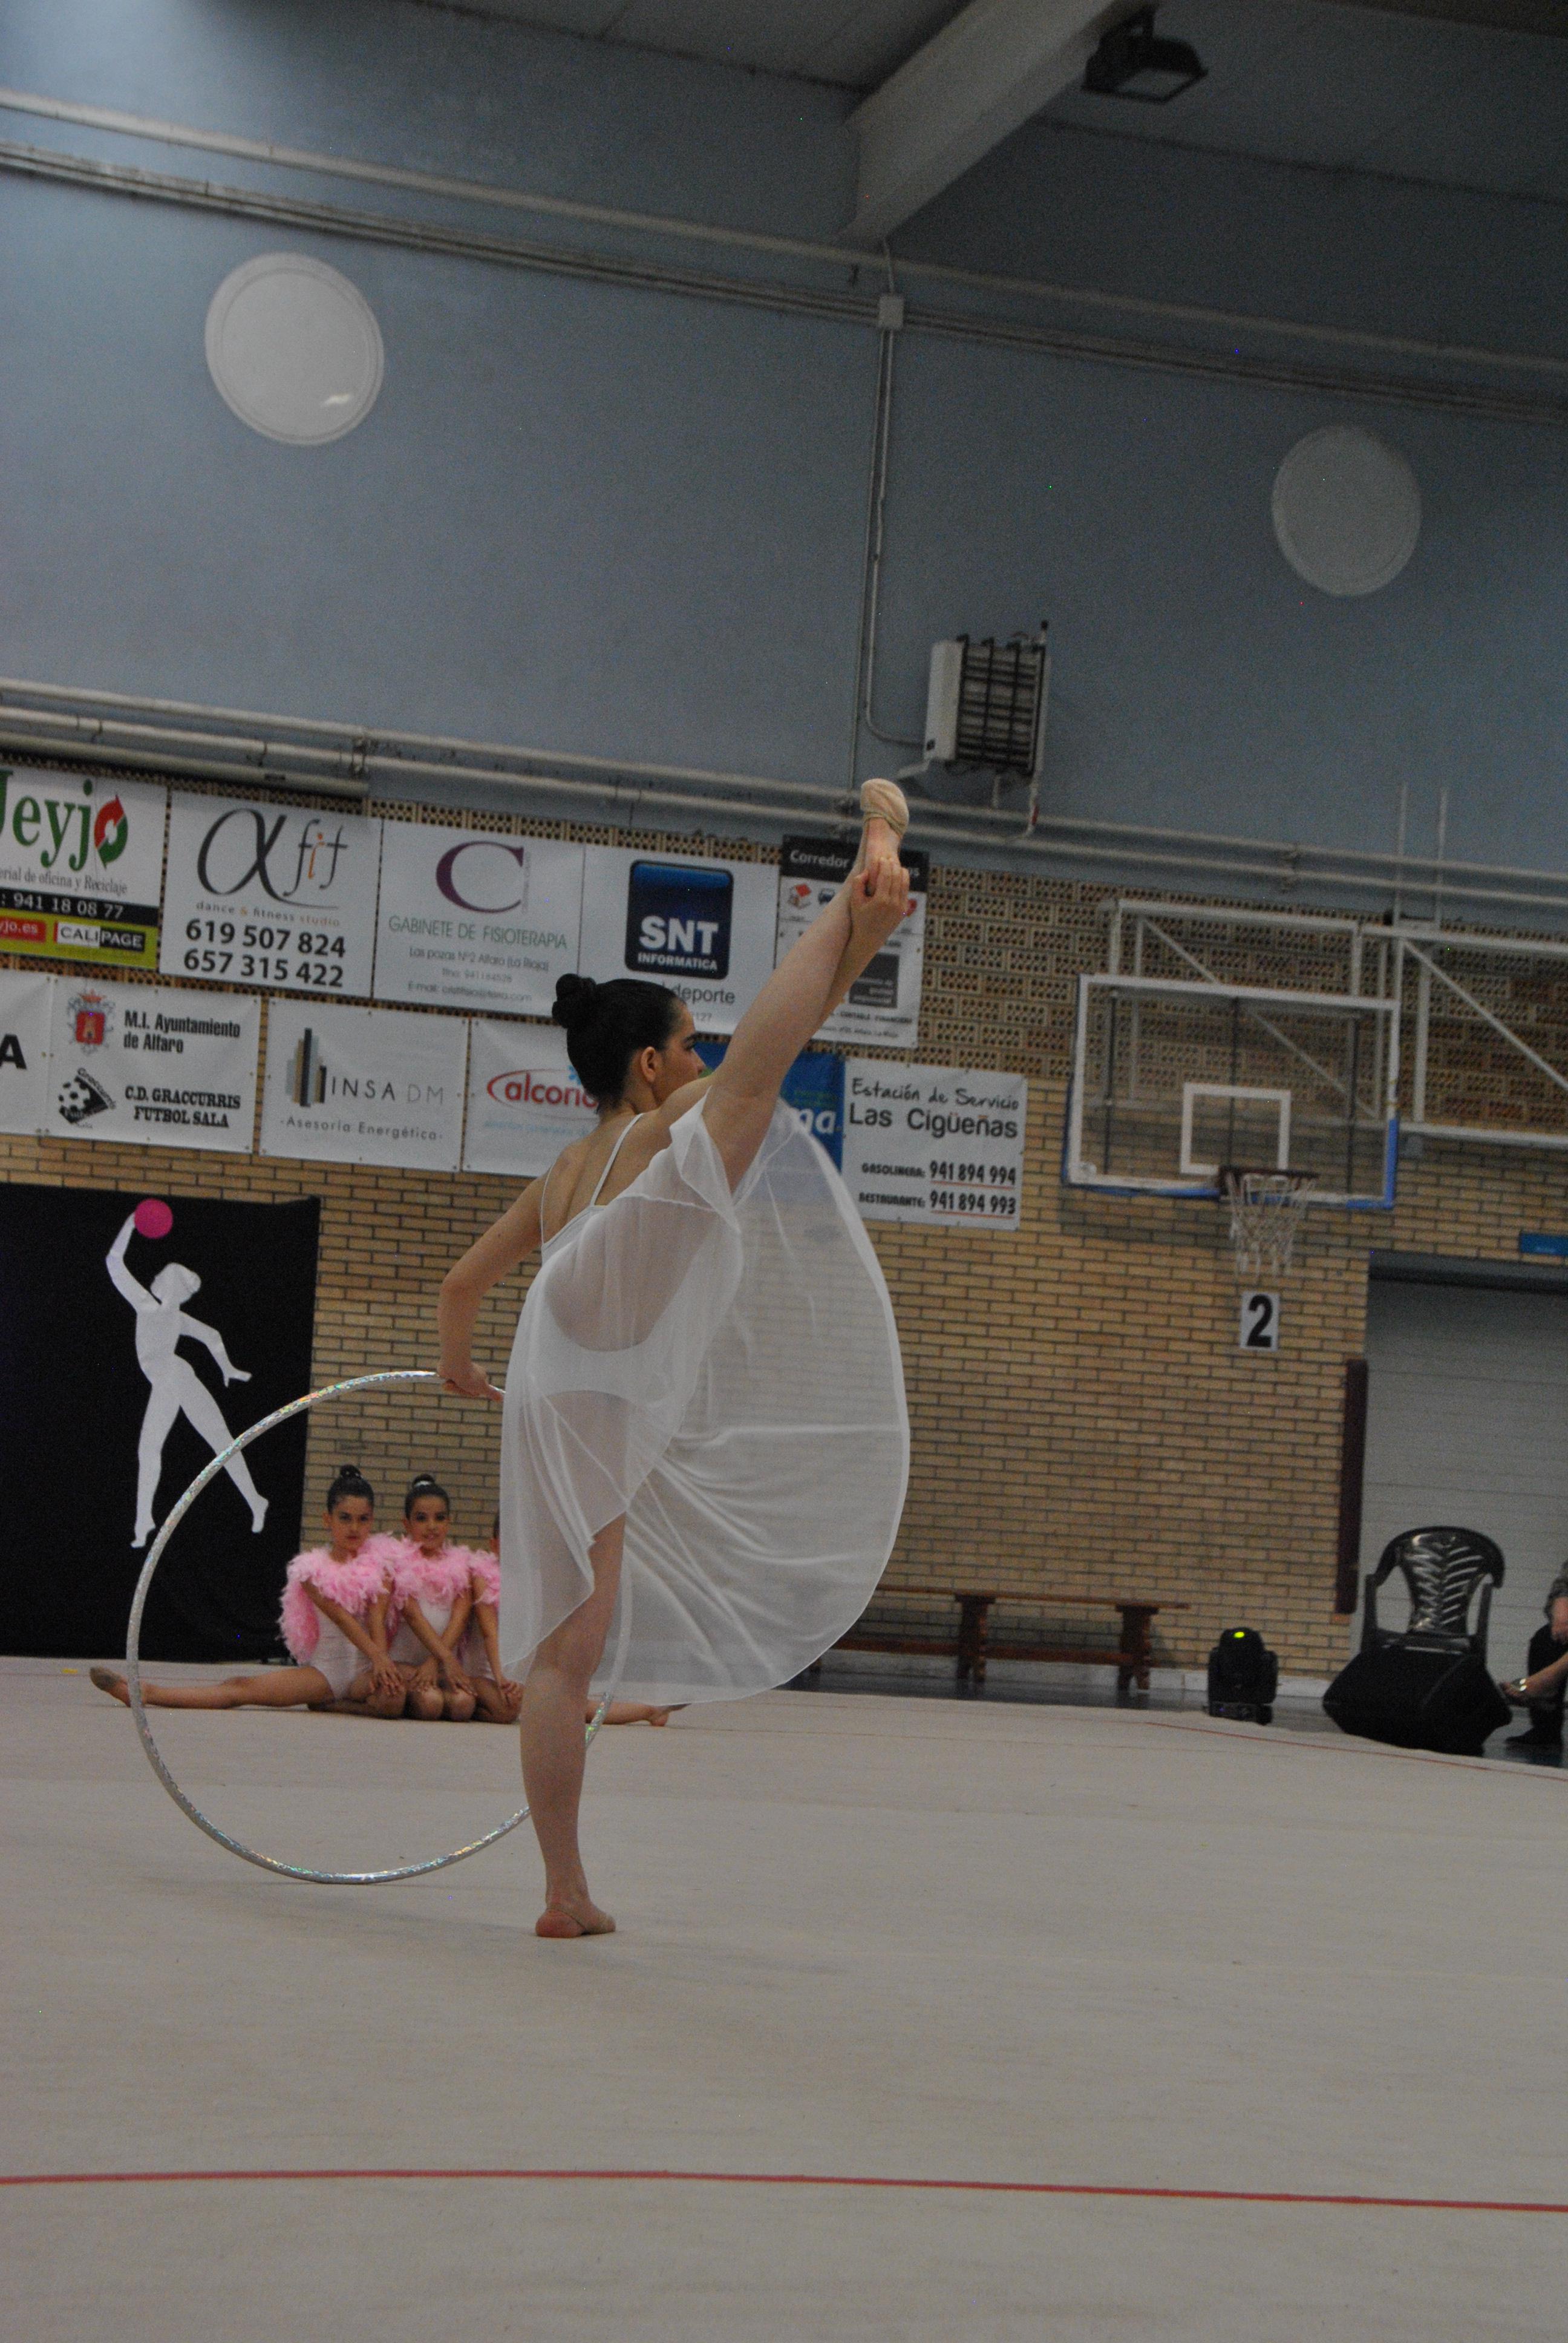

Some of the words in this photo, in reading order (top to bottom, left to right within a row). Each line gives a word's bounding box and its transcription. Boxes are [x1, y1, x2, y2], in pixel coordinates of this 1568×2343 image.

[790, 849, 849, 868] Corredor
[25, 870, 36, 883] de
[39, 871, 72, 888] oficina
[74, 878, 81, 891] y
[85, 875, 128, 896] Reciclaje
[13, 892, 43, 911] 941
[53, 897, 71, 914] 18
[77, 900, 97, 917] 08
[104, 903, 124, 919] 77
[196, 900, 235, 914] dance
[253, 908, 295, 922] fitness
[299, 915, 339, 928] studio
[186, 917, 235, 944] 619
[243, 924, 291, 951] 507
[298, 931, 346, 958] 824
[388, 915, 454, 938] GABINETE
[458, 922, 475, 940] DE
[483, 925, 567, 949] FISIOTERAPIA
[639, 915, 719, 955] SNT
[184, 948, 233, 974] 657
[241, 954, 289, 981] 315
[296, 961, 344, 988] 422
[638, 952, 717, 971] INFORMATICA
[125, 1010, 149, 1029] M.I.
[155, 1013, 241, 1038] Ayuntamiento
[124, 1031, 139, 1049] de
[143, 1033, 184, 1054] Alfaro
[125, 1086, 149, 1101] C.D.
[152, 1088, 241, 1110] GRACCURRIS
[332, 1076, 396, 1101] INSA
[407, 1084, 444, 1106] DM
[852, 1077, 920, 1101] Estación
[929, 1087, 949, 1104] de
[955, 1087, 1019, 1111] Servicio
[134, 1106, 191, 1124] FUTBOL
[193, 1112, 229, 1128] SALA
[849, 1103, 892, 1127] Las
[907, 1107, 1018, 1139] Cigüeñas
[861, 1162, 926, 1178] GASOLINERA:
[930, 1160, 955, 1180] 941
[958, 1163, 985, 1183] 894
[989, 1165, 1016, 1185] 994
[858, 1191, 926, 1208] RESTAURANTE:
[930, 1189, 955, 1210] 941
[958, 1192, 985, 1212] 894
[990, 1194, 1017, 1215] 993
[1246, 1294, 1272, 1348] 2
